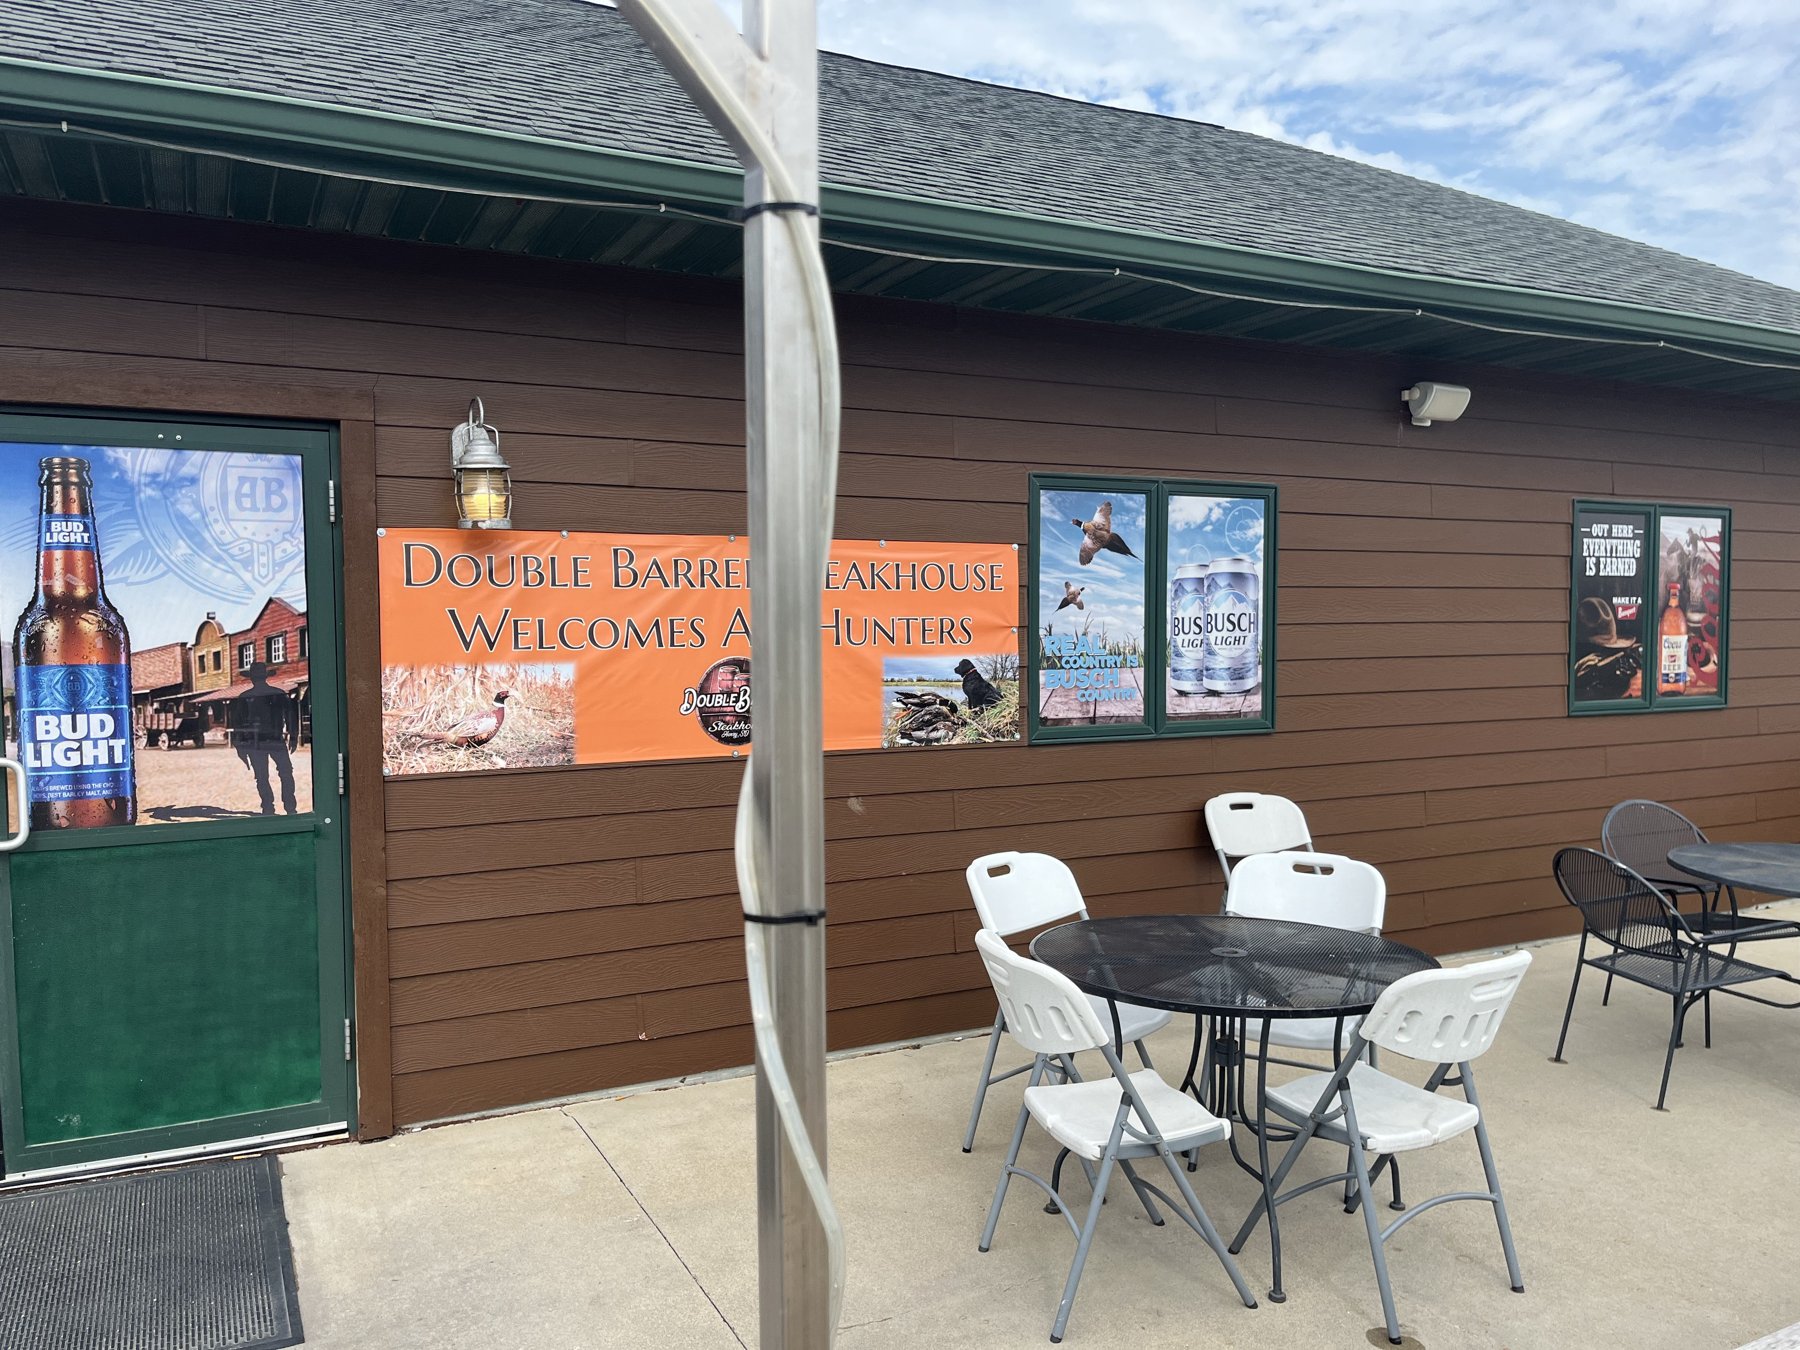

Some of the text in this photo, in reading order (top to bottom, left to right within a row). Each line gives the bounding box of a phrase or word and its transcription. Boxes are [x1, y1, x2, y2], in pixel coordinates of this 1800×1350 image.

[51, 521, 84, 533] BUD
[1591, 523, 1634, 538] OUT HERE
[45, 532, 90, 543] LIGHT
[1583, 538, 1641, 558] EVERYTHING
[823, 560, 1004, 592] EAKHOUSE
[1585, 557, 1637, 577] IS EARNED
[1612, 596, 1630, 604] MAKE
[445, 607, 706, 652] WELCOMES
[1173, 616, 1203, 637] BUS
[1206, 612, 1256, 634] BUSCH
[1045, 634, 1107, 656] REAL
[1181, 638, 1204, 649] LIG
[1214, 635, 1248, 646] LIGHT
[1061, 654, 1139, 669] COUNTRY IS
[1045, 668, 1119, 690] BUSCH
[1076, 687, 1138, 702] COUNTRY
[36, 713, 115, 740] BUD
[26, 738, 126, 768] LIGHT
